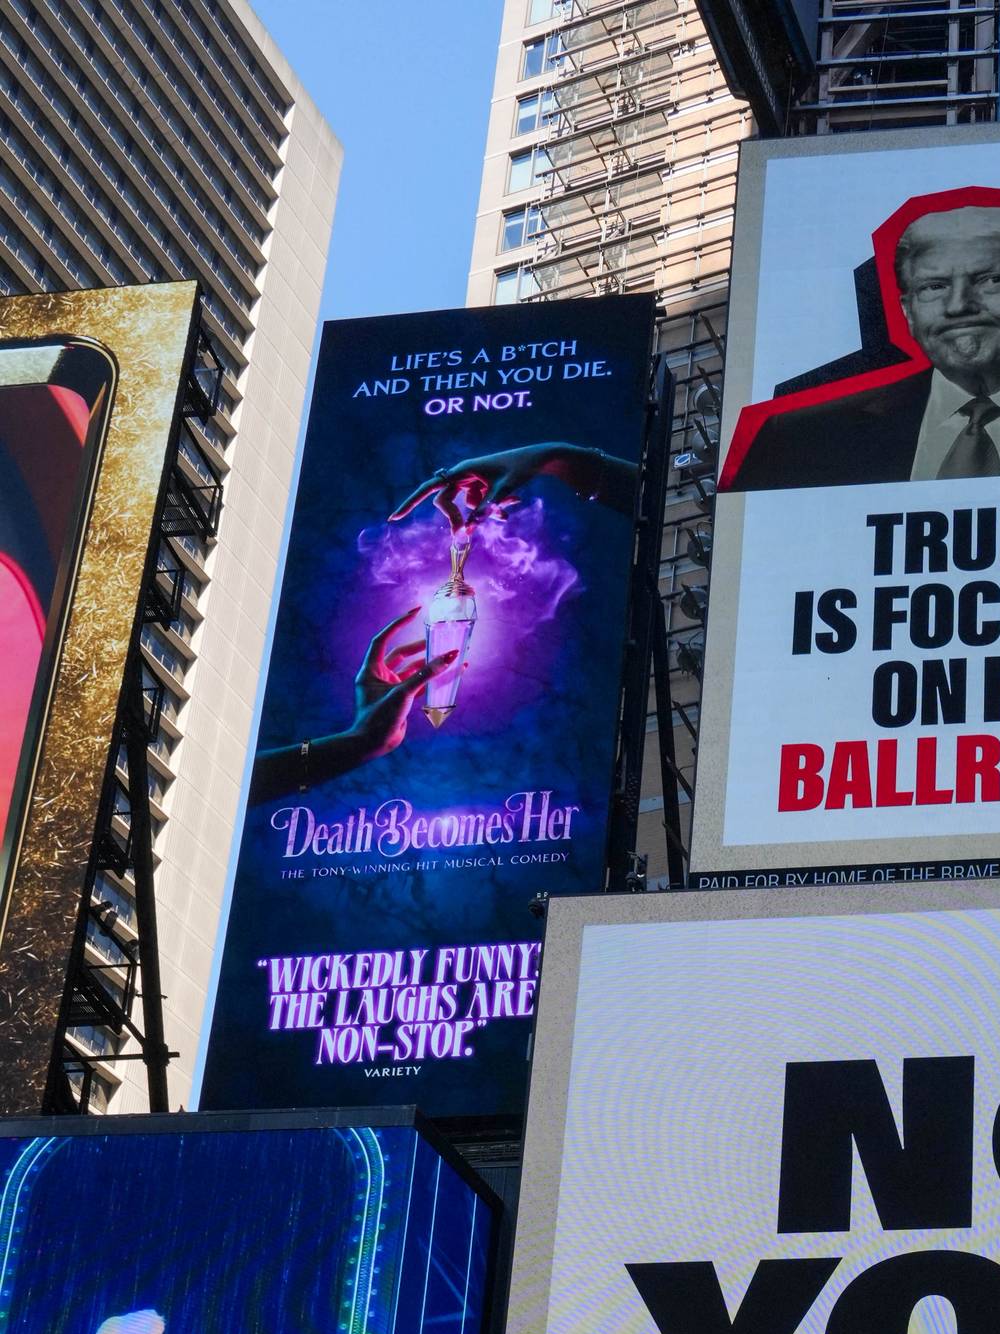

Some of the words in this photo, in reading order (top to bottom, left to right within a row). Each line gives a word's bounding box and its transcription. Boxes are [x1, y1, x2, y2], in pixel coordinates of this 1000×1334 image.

[472, 348, 490, 364] A
[353, 378, 409, 398] AND
[421, 371, 487, 392] THEN
[498, 365, 553, 385] YOU
[563, 361, 612, 380] DIE.
[424, 397, 464, 415] OR
[473, 391, 532, 412] NOT.
[791, 590, 857, 656] IS
[871, 657, 967, 730] ON
[271, 806, 372, 858] Death
[375, 799, 516, 857] Becomes
[505, 790, 579, 843] Her
[281, 869, 305, 879] THE
[312, 861, 410, 878] TONY-WINNING
[416, 860, 438, 871] HIT
[445, 856, 504, 870] MUSICAL
[510, 851, 571, 866] COMEDY
[699, 876, 739, 889] PAID
[745, 874, 780, 888] FOR
[814, 869, 867, 885] HOME
[872, 868, 896, 882] OF
[900, 866, 936, 881] THE
[269, 992, 327, 1030] THE
[335, 984, 457, 1027] LAUGHS
[466, 980, 537, 1018] ARE
[364, 1066, 422, 1077] VARIETY
